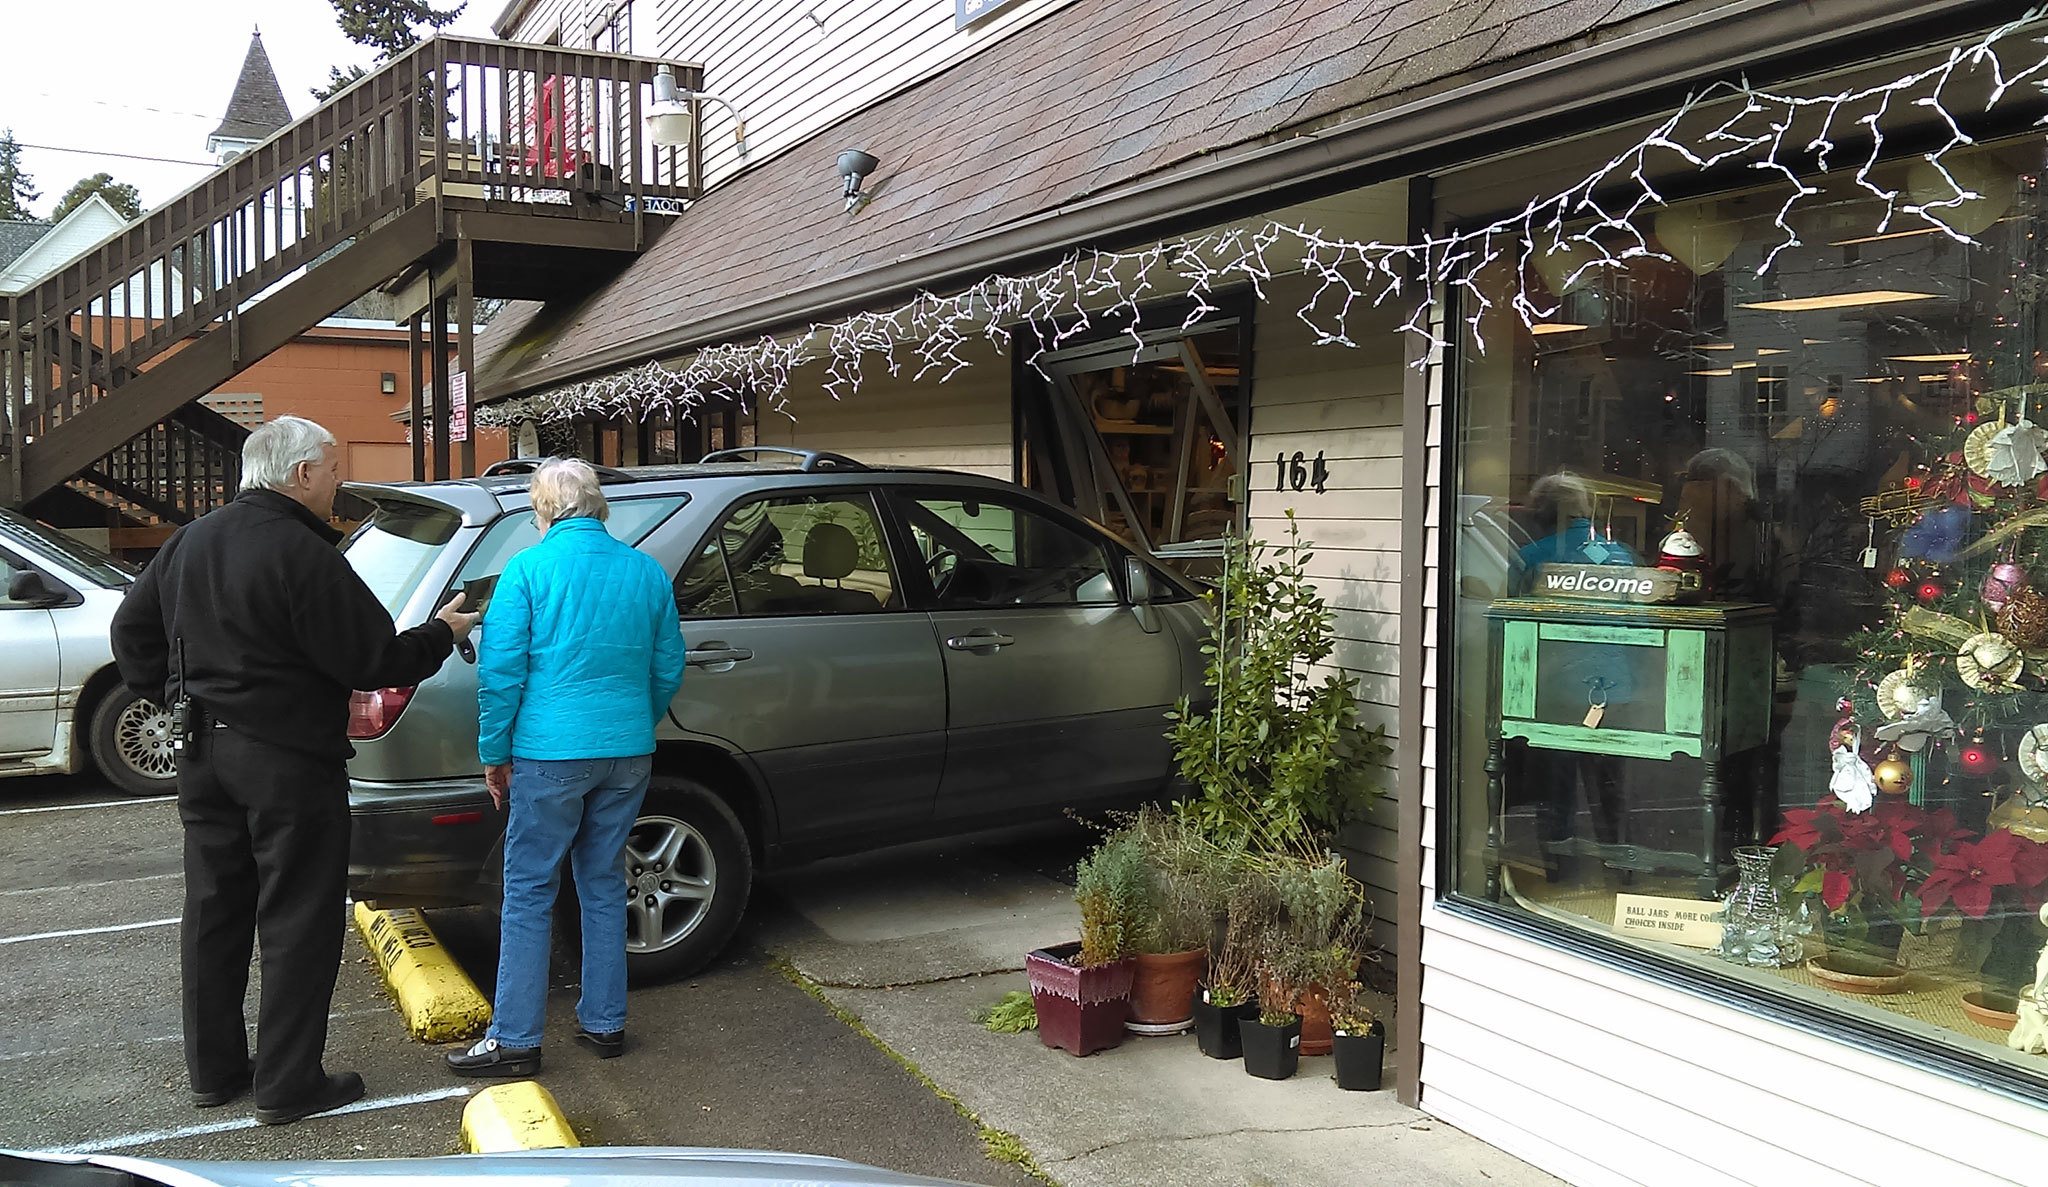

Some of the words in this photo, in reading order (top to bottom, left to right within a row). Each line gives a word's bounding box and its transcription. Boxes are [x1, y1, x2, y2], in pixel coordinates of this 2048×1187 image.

[644, 199, 680, 212] DOVE
[1276, 450, 1330, 494] 164
[1546, 570, 1654, 595] welcome
[1626, 906, 1646, 917] BALL
[1647, 908, 1669, 918] JARS
[1674, 911, 1698, 921] MORE
[1625, 917, 1656, 928] CHOICES
[1658, 920, 1685, 931] INSIDE
